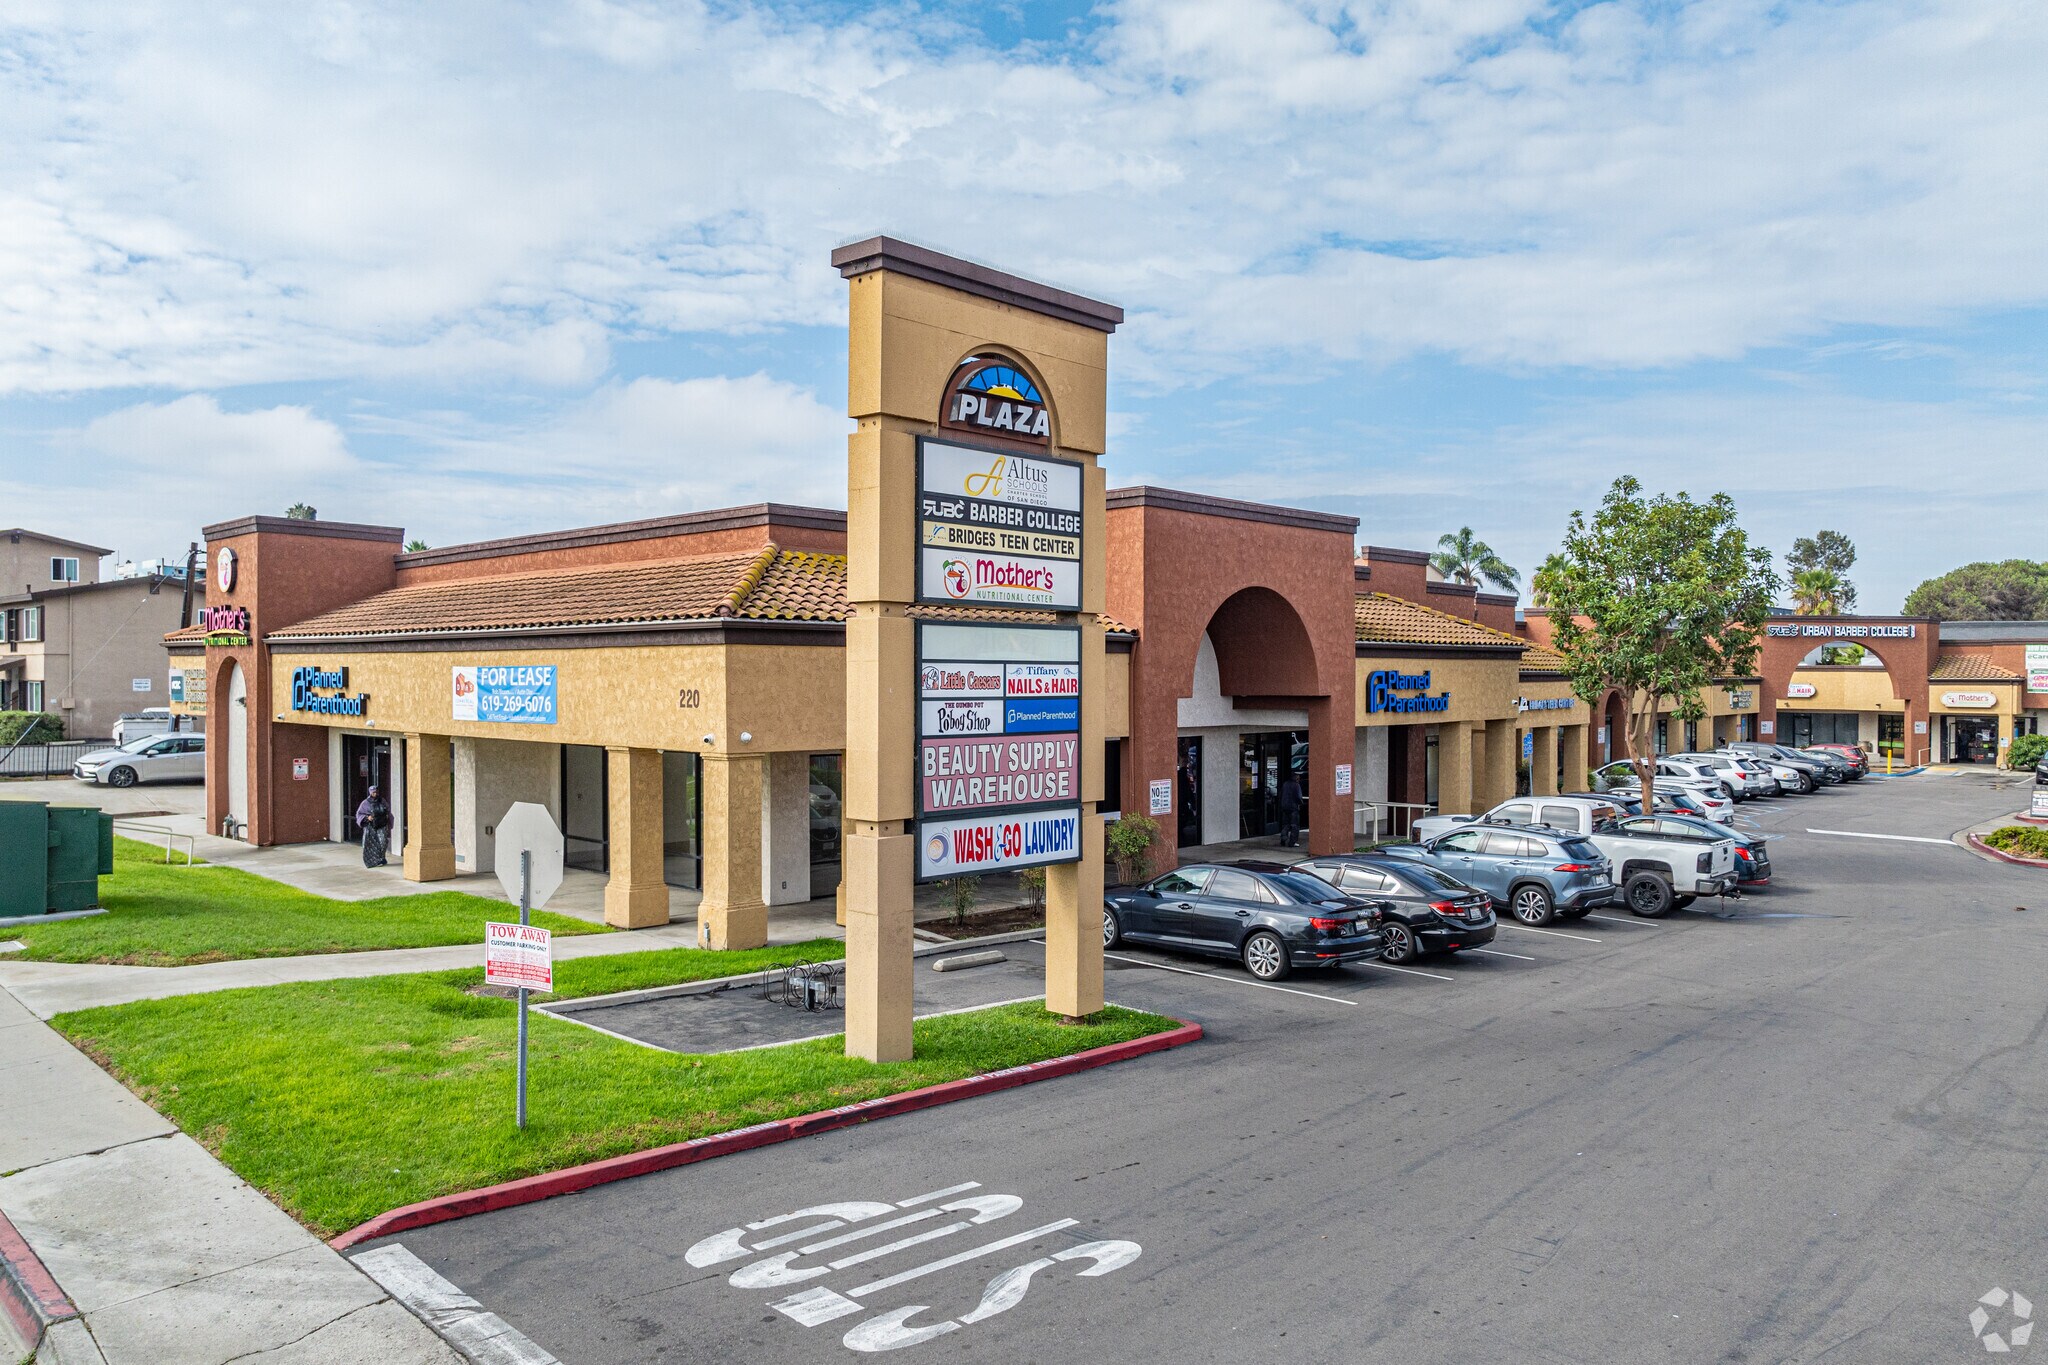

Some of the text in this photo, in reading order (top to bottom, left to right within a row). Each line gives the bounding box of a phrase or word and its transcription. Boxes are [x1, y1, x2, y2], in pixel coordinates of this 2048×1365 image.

[957, 393, 1050, 437] PLAZA
[1007, 458, 1048, 484] Altus
[1007, 478, 1048, 493] SCHOOLS
[969, 502, 1024, 527] BARBER
[1027, 512, 1081, 533] COLLEGE
[948, 527, 996, 547] BRIDGES
[1000, 533, 1029, 550] TEEN
[1033, 537, 1075, 555] CENTER
[976, 558, 1054, 590] Mother's
[976, 590, 1054, 603] NUTRITIONAL CENTER
[204, 605, 245, 632] Mother's
[1801, 624, 1832, 637] URBAN
[1834, 625, 1868, 637] BARBER
[1870, 625, 1909, 637] COLLEGE
[305, 666, 343, 689] Planned
[480, 666, 552, 686] FOR LEASE
[940, 670, 1001, 691] Little Caesars
[1026, 666, 1060, 677] Tiffany
[1388, 670, 1431, 690] Planned
[1008, 678, 1078, 694] NAILS & HAIR
[305, 691, 362, 717] Parenthood
[481, 695, 552, 712] 619-269-6076
[679, 688, 700, 709] 220
[1388, 692, 1449, 713] Parenthood
[1958, 694, 1989, 702] Mother's
[966, 709, 991, 732] Shop
[1016, 711, 1076, 721] Planned Parenthood
[923, 739, 1077, 778] BEAUTY SUPPLY
[931, 770, 1070, 808] WAREHOUSE
[1151, 787, 1160, 798] NO
[953, 824, 994, 864] WASH
[1003, 822, 1022, 859] GO
[1025, 817, 1076, 856] LAUNDRY
[490, 925, 547, 944] TOW AWAY
[490, 939, 516, 947] CUSTOMER
[516, 942, 536, 950] PARKING
[684, 1181, 1142, 1352] STOP
